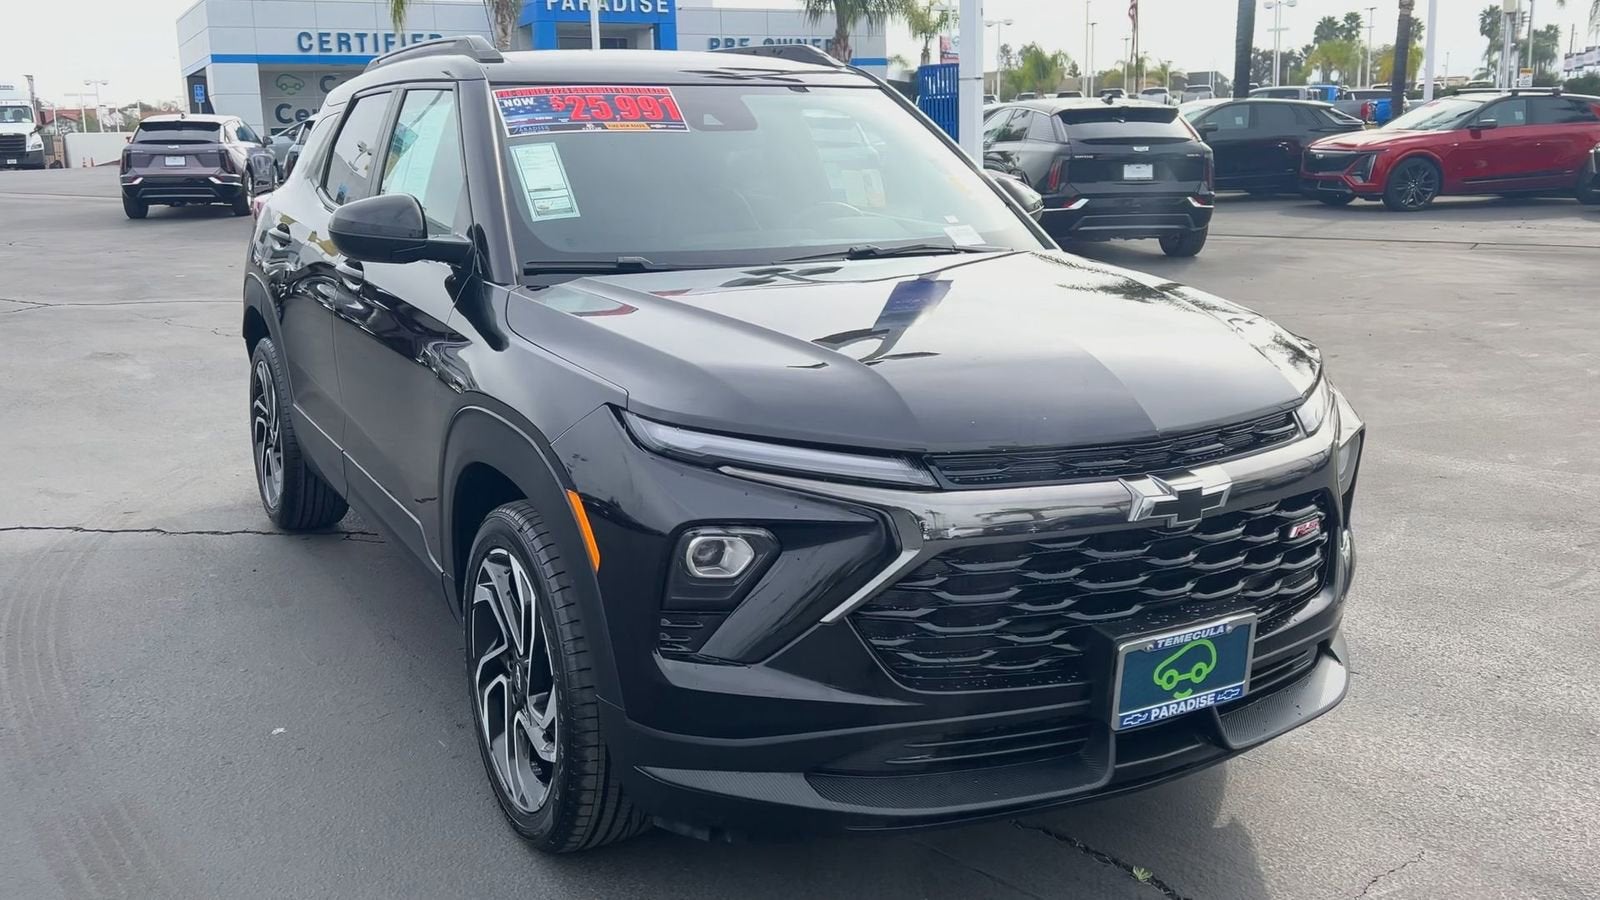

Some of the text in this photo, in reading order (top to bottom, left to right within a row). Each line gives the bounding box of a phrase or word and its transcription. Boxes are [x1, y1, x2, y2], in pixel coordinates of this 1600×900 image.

[546, 0, 670, 13] PARADISE
[503, 97, 535, 107] NOW
[549, 95, 682, 121] $25,991
[1157, 625, 1225, 649] TEMECULA
[1151, 694, 1216, 720] PARADISE
